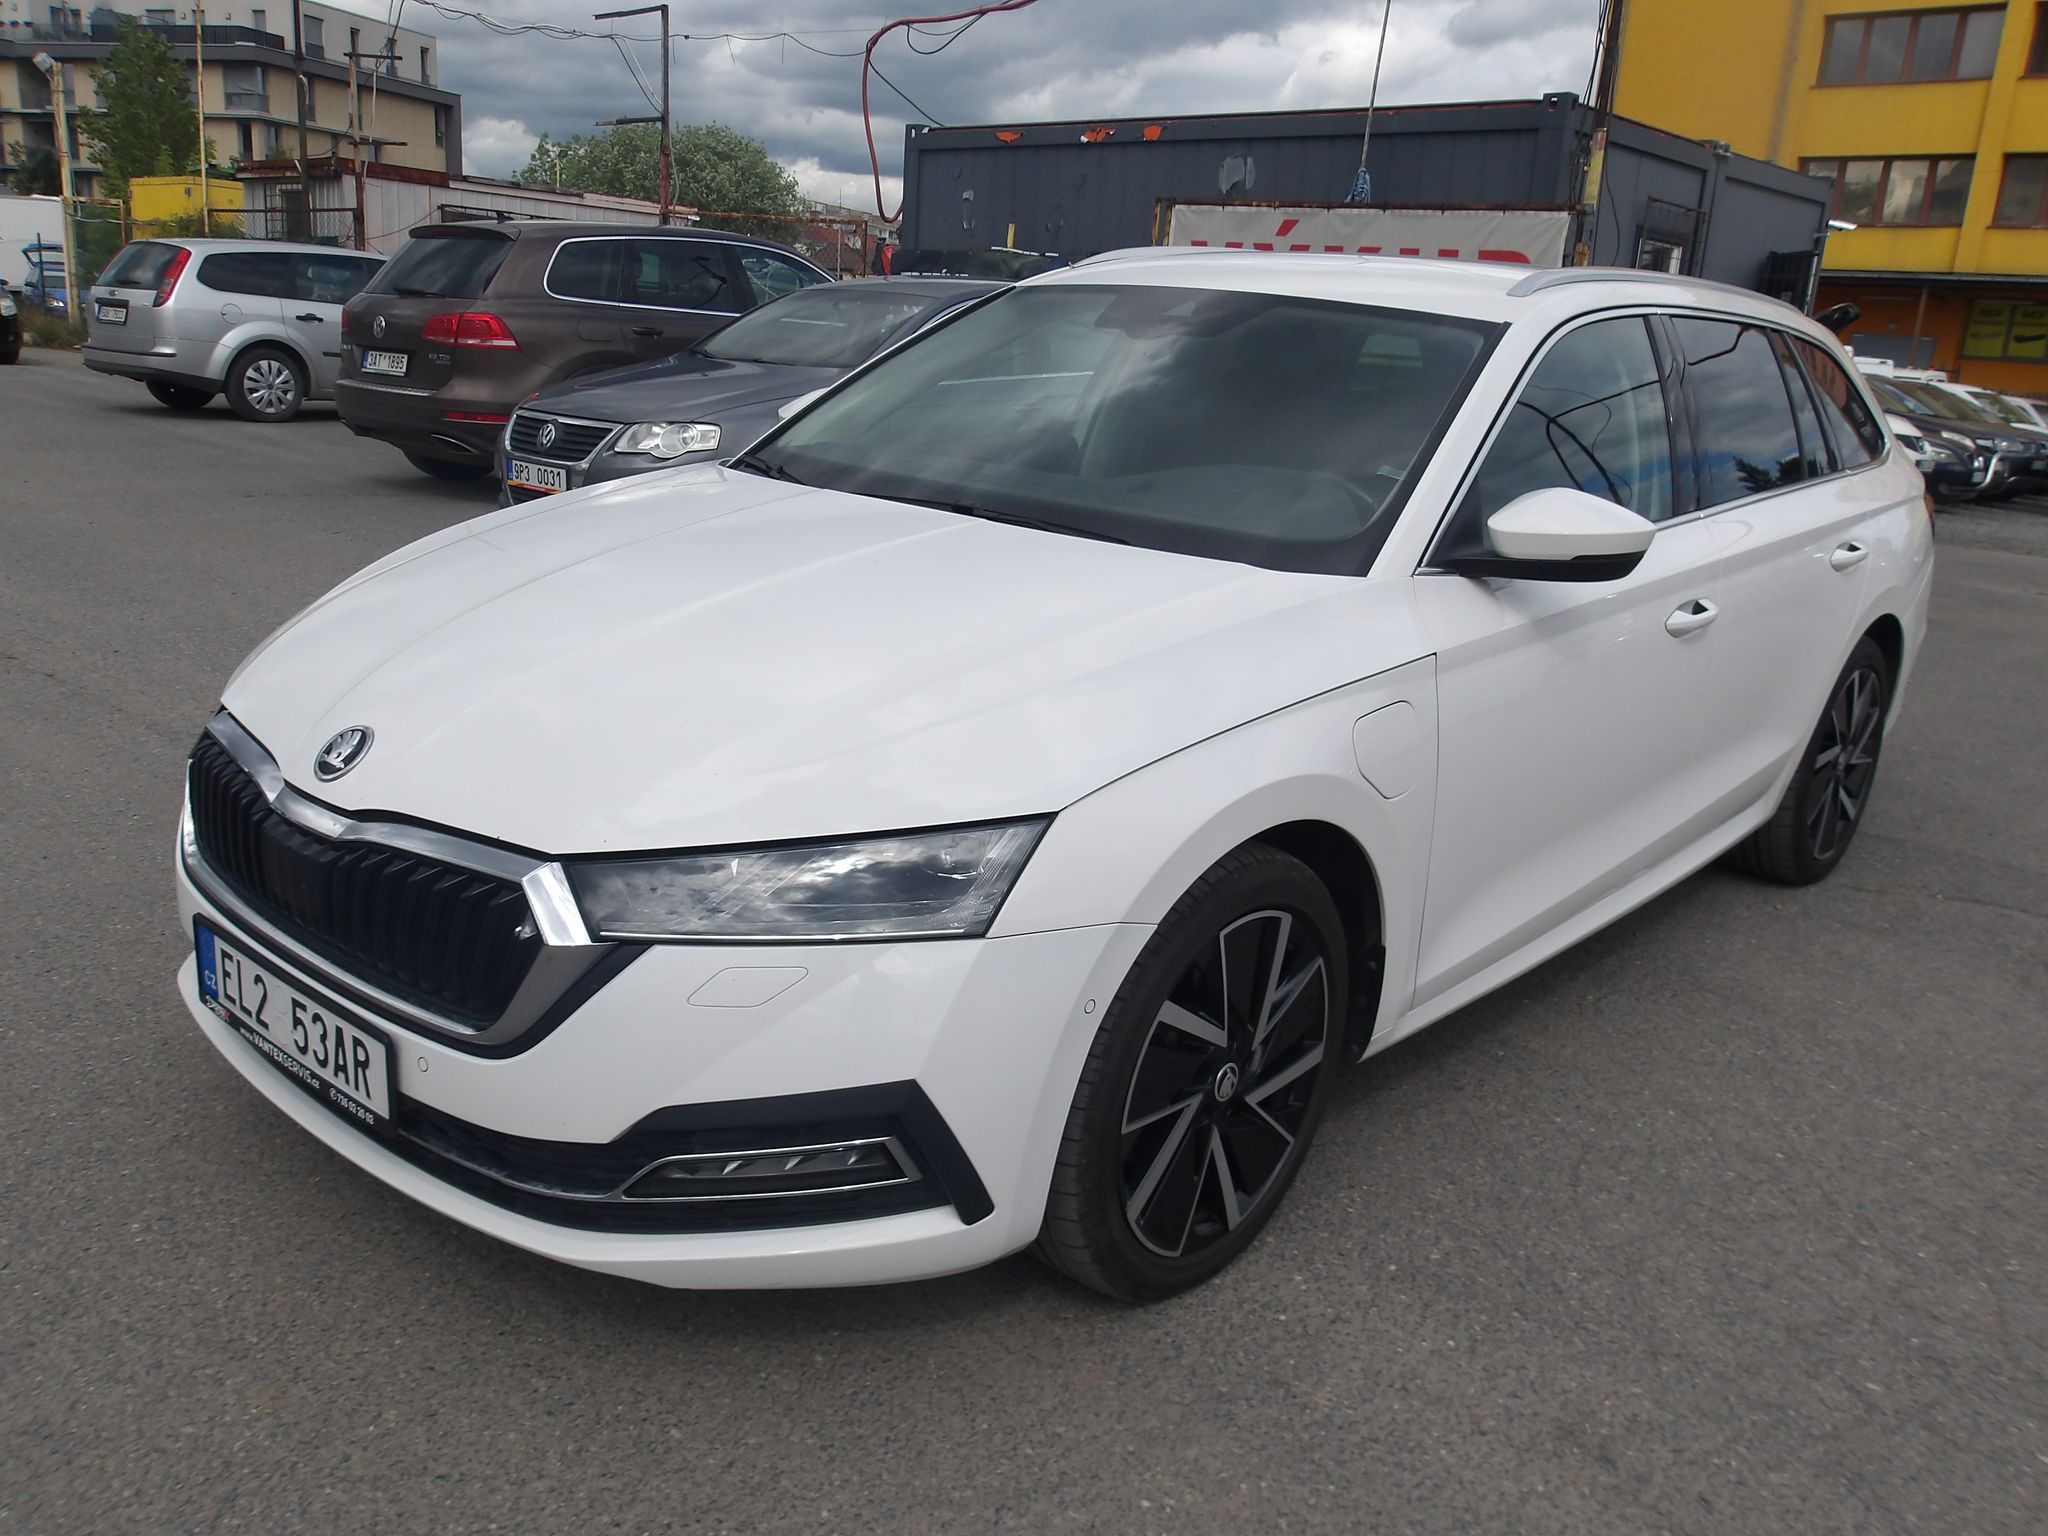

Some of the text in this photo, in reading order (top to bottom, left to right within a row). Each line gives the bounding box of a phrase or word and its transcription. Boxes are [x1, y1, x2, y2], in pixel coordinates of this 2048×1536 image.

[368, 353, 406, 370] 3AT 1895
[514, 462, 530, 482] 9P3
[537, 467, 562, 489] 0031
[220, 947, 372, 1100] EL2 53AR
